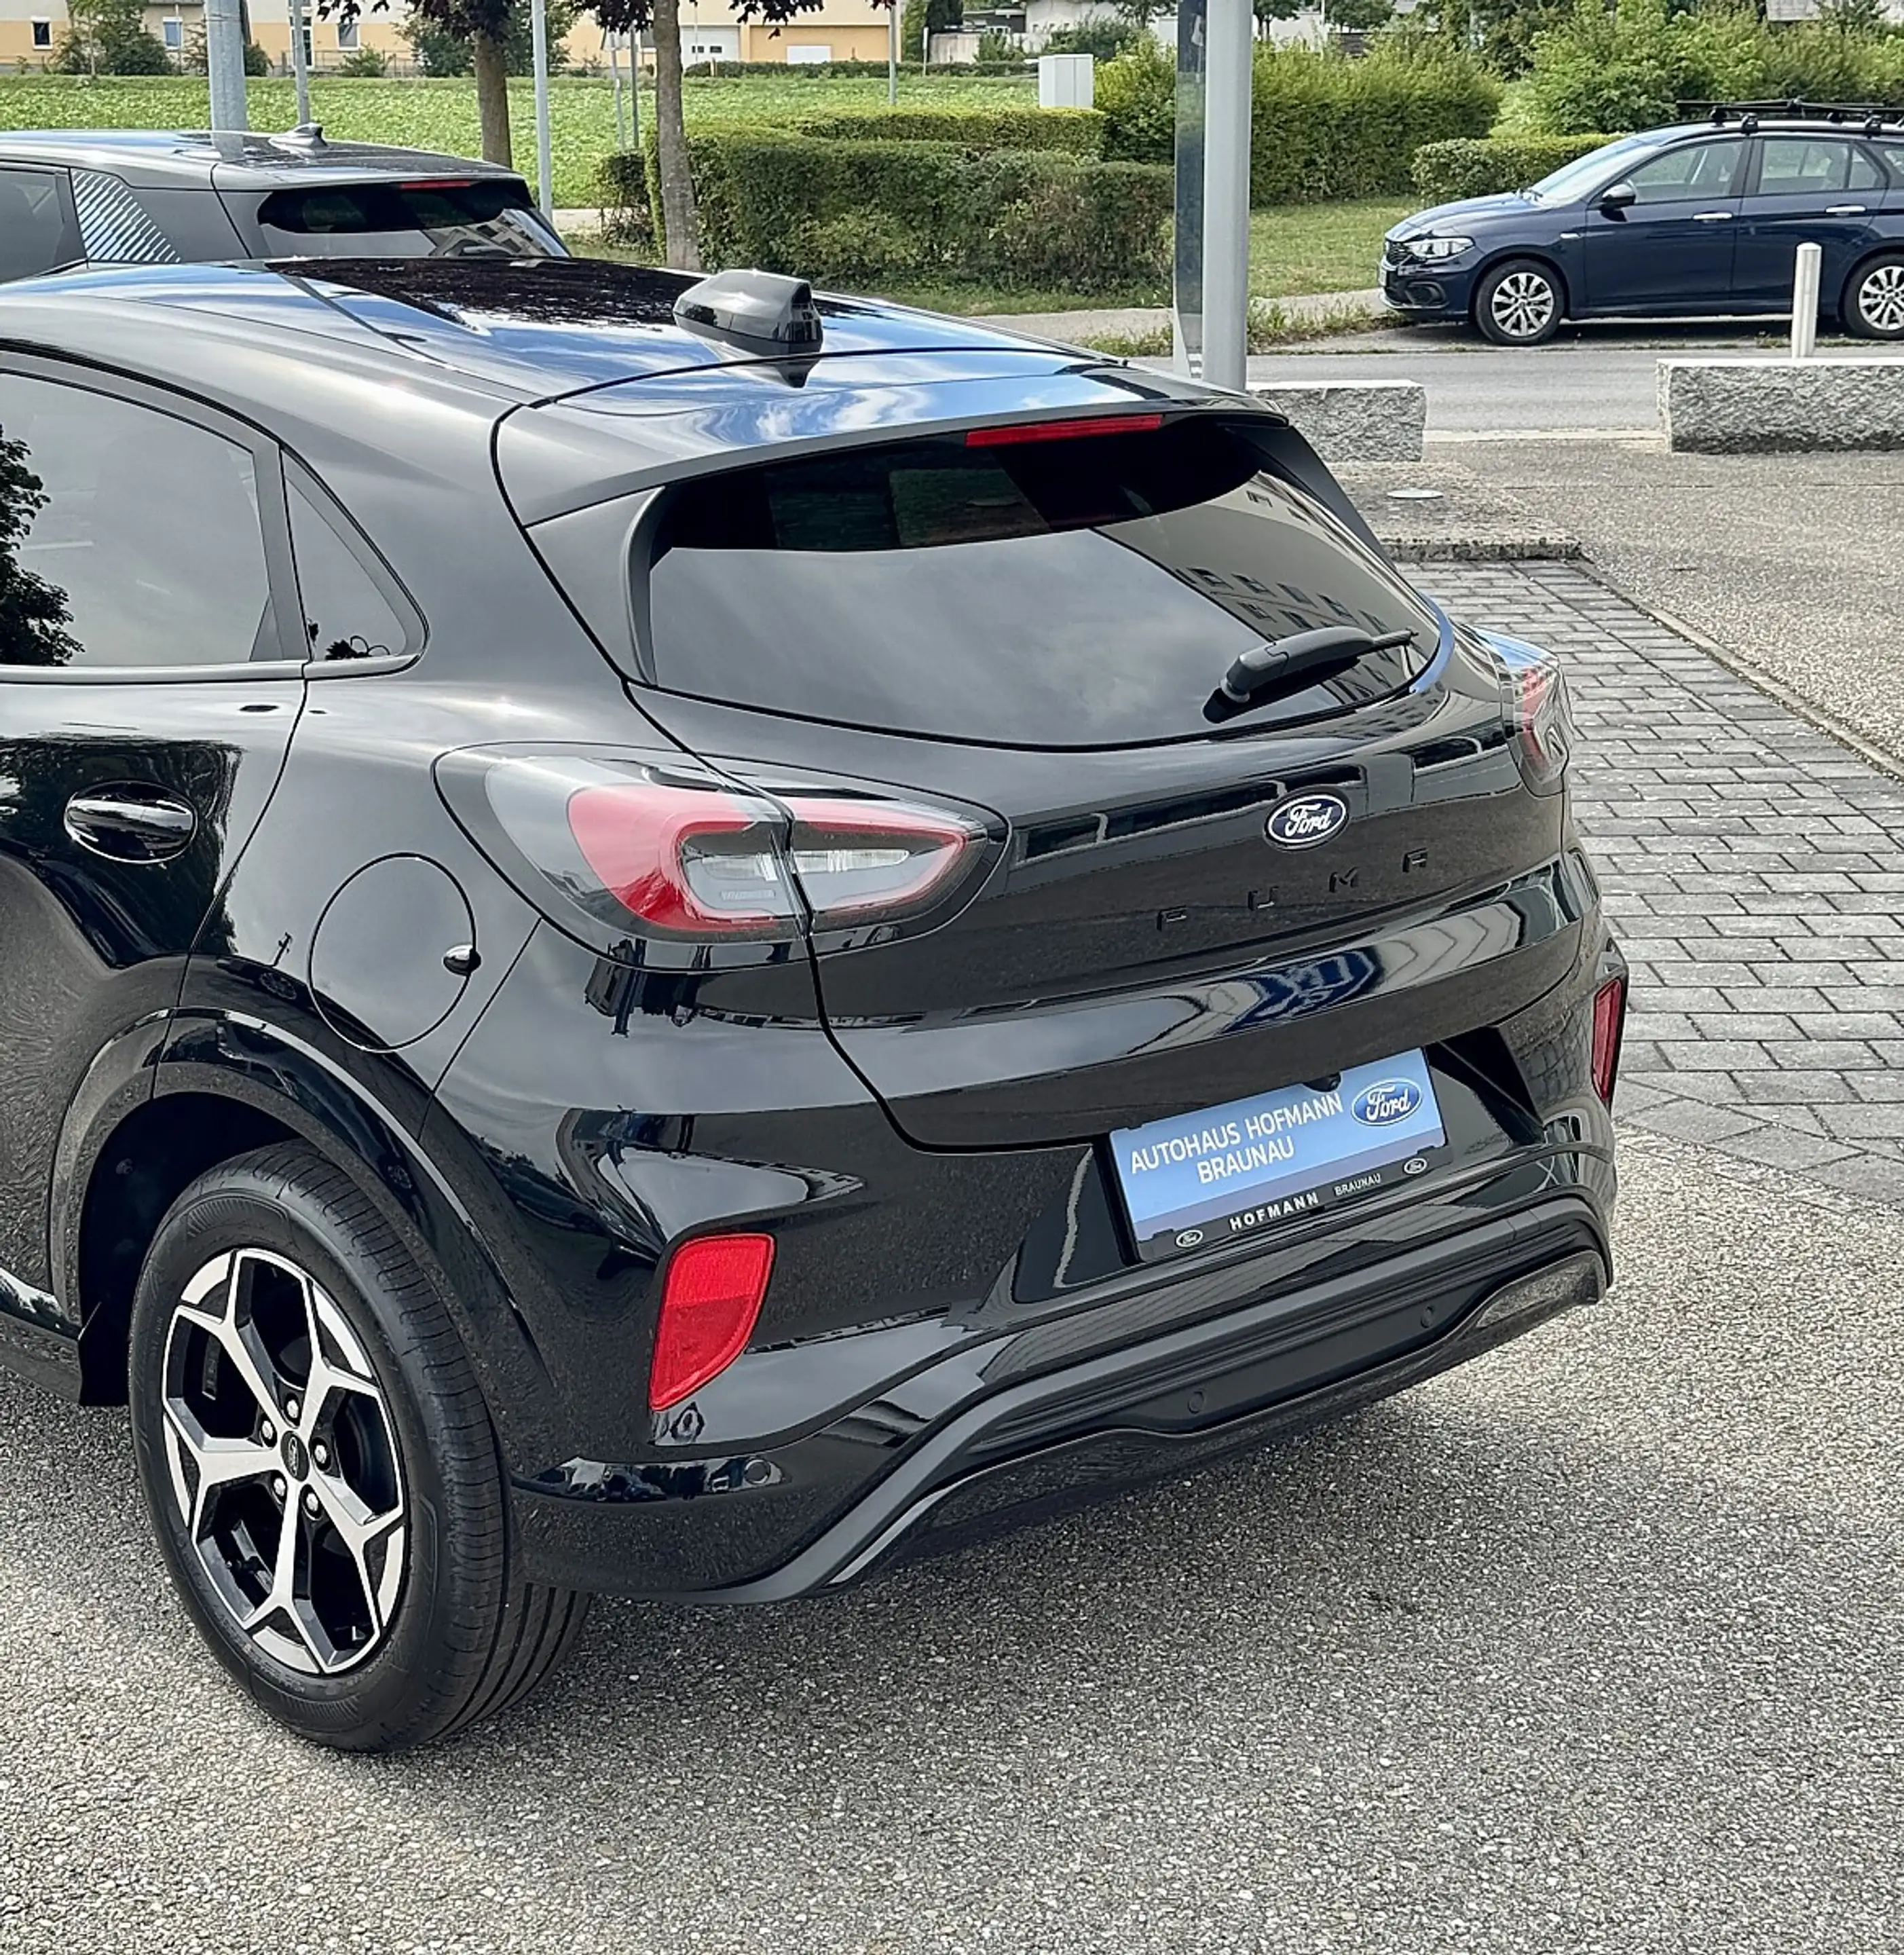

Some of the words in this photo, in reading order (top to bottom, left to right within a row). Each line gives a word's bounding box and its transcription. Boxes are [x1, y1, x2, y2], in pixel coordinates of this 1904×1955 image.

[1285, 802, 1333, 837] Ford
[1156, 846, 1429, 931] PUMA
[1366, 1084, 1411, 1121] Ford
[1130, 1122, 1241, 1174] AUTOHAUS
[1244, 1092, 1344, 1140] HOFMANN
[1196, 1135, 1295, 1184] BRAUNAU
[1229, 1191, 1319, 1231] HOFMANN
[1333, 1172, 1381, 1196] BRAUNAU
